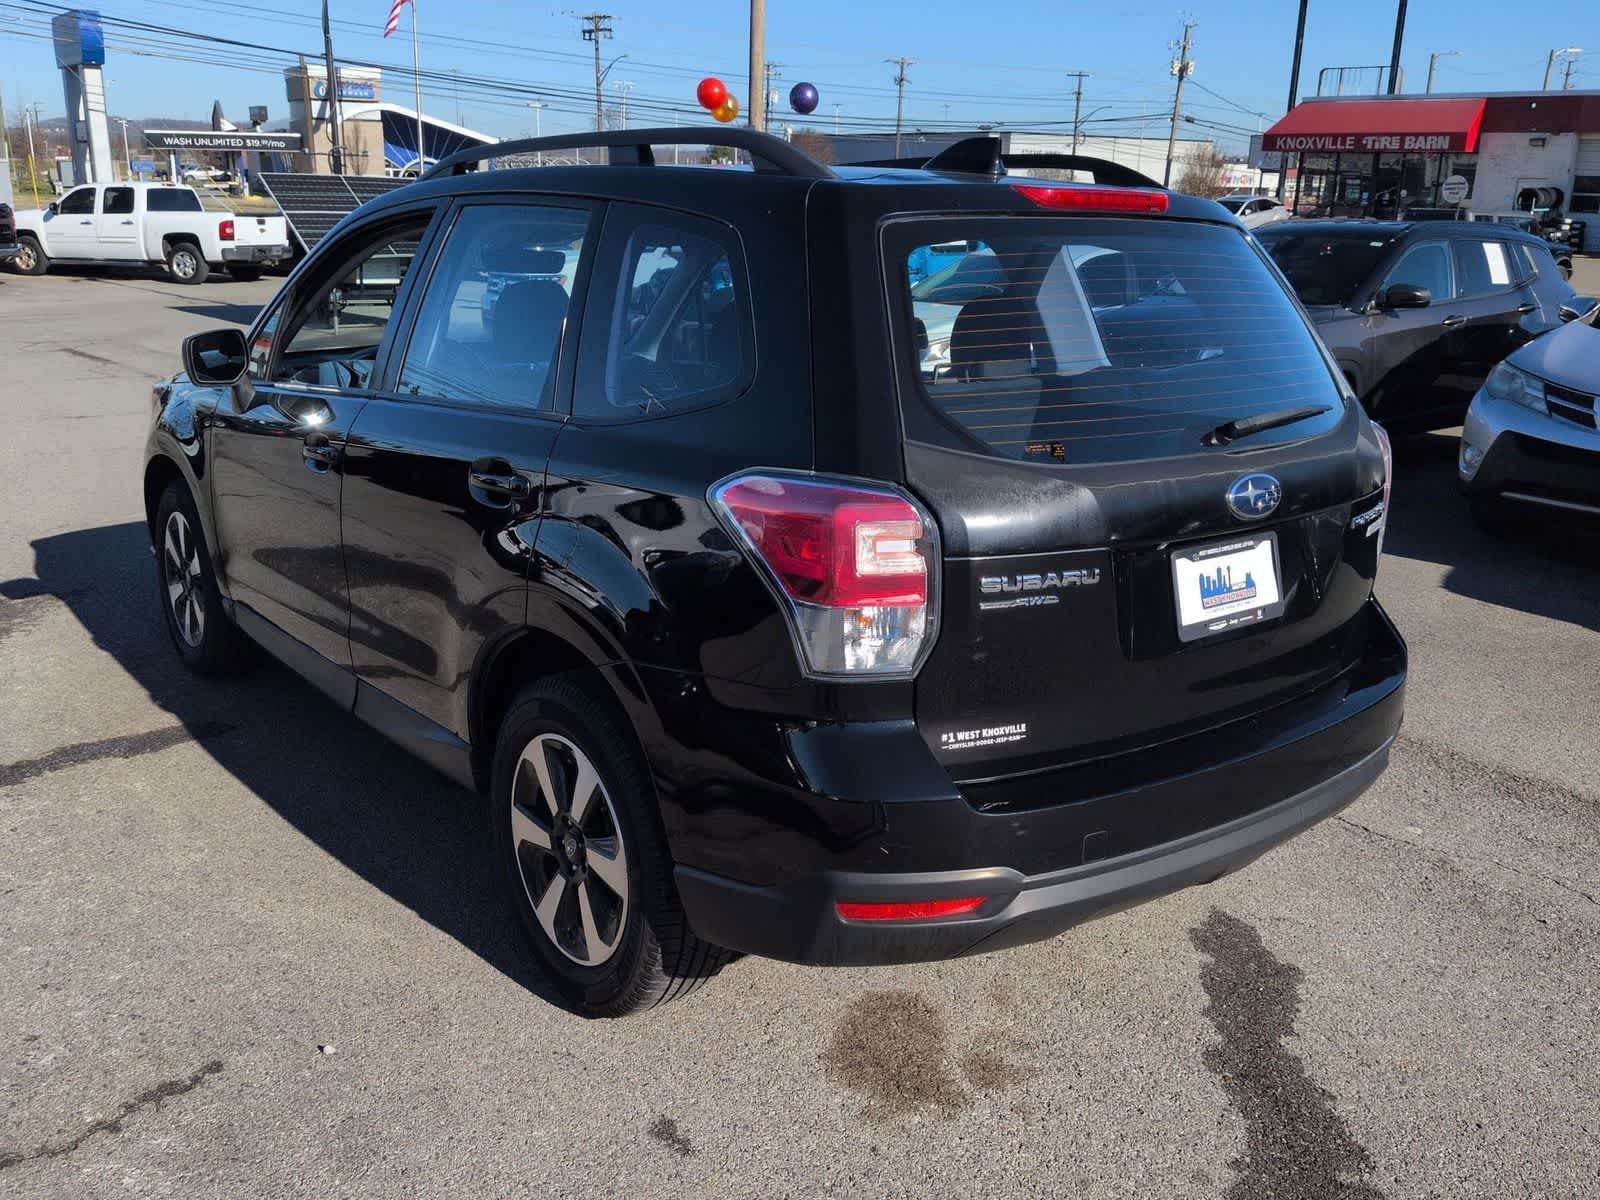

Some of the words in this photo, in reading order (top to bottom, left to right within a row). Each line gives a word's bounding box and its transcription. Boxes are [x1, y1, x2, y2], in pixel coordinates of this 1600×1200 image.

[163, 136, 193, 146] WASH
[194, 137, 244, 147] UNLIMITED
[1276, 136, 1355, 150] KNOXVILLE
[1404, 135, 1451, 150] BARN
[980, 568, 1100, 593] SUBARU
[941, 732, 956, 743] #1
[956, 730, 981, 741] WEST
[982, 723, 1027, 738] KNOXVILLE
